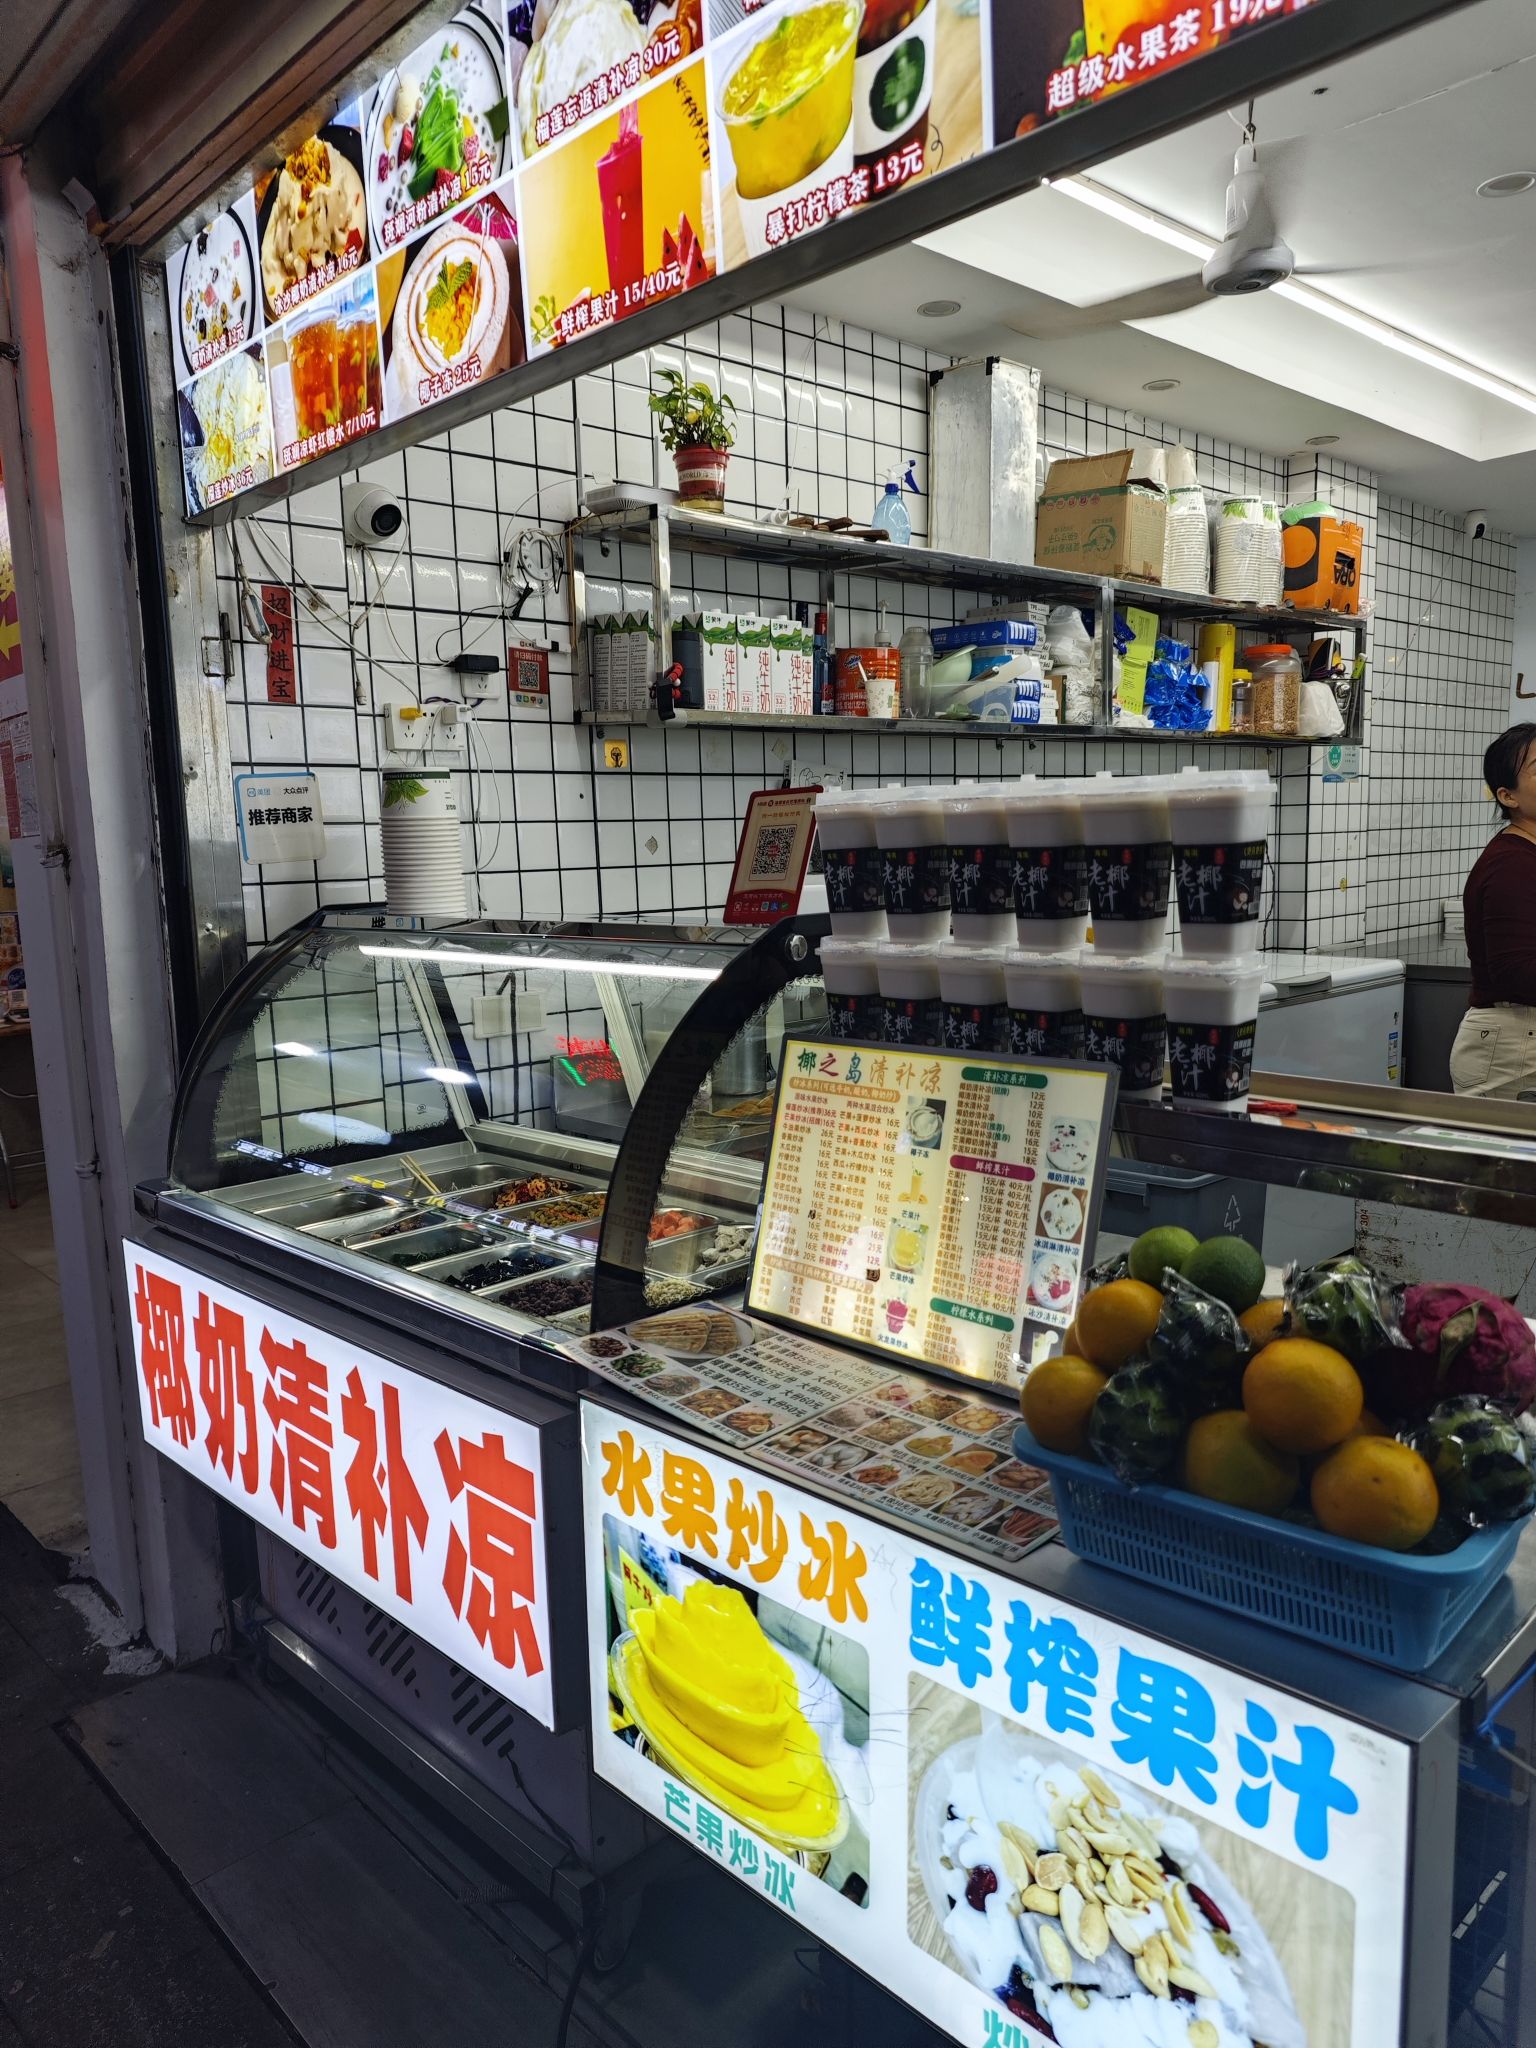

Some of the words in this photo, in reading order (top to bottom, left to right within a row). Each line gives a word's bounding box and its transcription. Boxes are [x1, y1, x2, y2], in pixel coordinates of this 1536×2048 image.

[1048, 8, 1202, 110] 超级水果茶
[536, 53, 641, 146] 榴莲忘返清补凉
[643, 29, 681, 73] 30元
[464, 154, 491, 191] 15元
[765, 163, 870, 244] 暴打柠檬茶
[874, 143, 924, 193] 13元
[274, 260, 336, 317] 冰沙椰奶清补凉
[337, 245, 358, 274] 16元
[559, 292, 620, 339] 鲜榨果汁
[624, 262, 683, 307] 15/40元
[418, 369, 454, 404] 椰子冻
[455, 355, 482, 389] 25元
[346, 412, 376, 436] 7/10元
[207, 477, 236, 504] 榴莲炒冰
[267, 593, 292, 698] 招财进宝
[725, 648, 736, 711] 纯牛奶
[759, 651, 770, 712] 纯牛奶
[791, 654, 802, 714] 纯牛奶
[283, 787, 308, 795] 大众点评
[248, 807, 313, 826] 推荐商家
[794, 1046, 944, 1094] 椰之岛清补凉
[983, 1071, 1027, 1085] 清补凉系列
[794, 1092, 828, 1104] 原味水果炒冰
[959, 1082, 1010, 1096] 椰奶清补凉(招牌)
[1030, 1091, 1046, 1101] 12元
[846, 1100, 895, 1114] 两种水果混合炒冰
[956, 1100, 989, 1112] 糖水清补凉
[1028, 1109, 1043, 1119] 10元
[1029, 1100, 1044, 1110] 12元
[840, 1110, 881, 1124] 芒果+菠萝炒冰
[886, 1117, 900, 1128] 16元
[954, 1117, 1005, 1133] 冰沙清补凉(推荐)
[1025, 1127, 1041, 1138] 16元
[1026, 1118, 1042, 1128] 16元
[780, 1133, 804, 1143] 香蕉炒冰
[838, 1122, 880, 1136] 芒果+西瓜炒冰
[884, 1129, 898, 1140] 16元
[953, 1126, 1010, 1143] 冰淇淋清补凉(推荐)
[1024, 1137, 1039, 1147] 16元
[779, 1142, 802, 1153] 木瓜炒冰
[836, 1134, 878, 1149] 芒果+香蕉炒冰
[882, 1142, 897, 1153] 16元
[910, 1148, 929, 1158] 椰子冻
[951, 1135, 998, 1150] 芒果椰奶清补凉
[1022, 1146, 1038, 1156] 15元
[778, 1151, 801, 1163] 柠檬炒冰
[834, 1146, 876, 1161] 芒果+木瓜炒冰
[880, 1155, 895, 1166] 16元
[1021, 1155, 1037, 1165] 18元
[776, 1161, 799, 1173] 西瓜炒冰
[833, 1158, 874, 1174] 西瓜+柠檬炒冰
[947, 1170, 966, 1181] 芒果汁
[975, 1160, 1010, 1175] 鲜榨果汁
[877, 1179, 891, 1190] 16元
[946, 1179, 965, 1190] 西瓜汁
[1046, 1171, 1086, 1187] 椰奶清补凉
[829, 1182, 864, 1197] 芒果+哈密瓜
[875, 1192, 889, 1203] 16元
[945, 1188, 964, 1199] 木瓜汁
[873, 1204, 888, 1216] 16元
[901, 1209, 920, 1221] 芒果汁
[871, 1217, 886, 1228] 16元
[870, 1230, 884, 1241] 16元
[1033, 1237, 1080, 1257] 冰淇淋清补凉
[866, 1255, 880, 1267] 12元
[889, 1271, 914, 1285] 芒果炒冰
[790, 1285, 803, 1296] 木瓜
[950, 1304, 994, 1326] 柠檬水系列
[1027, 1306, 1067, 1325] 冰沙清补凉
[927, 1311, 947, 1324] 柠檬水
[1001, 1332, 1012, 1343] 7元
[877, 1333, 908, 1350] 火龙果炒冰
[996, 1340, 1011, 1352] 10元
[993, 1359, 1008, 1371] 10元
[994, 1350, 1010, 1362] 10元
[811, 1374, 859, 1395] 大份50元
[992, 1369, 1007, 1381] 10元
[778, 1388, 826, 1410] 大份60元
[795, 1381, 843, 1402] 大份50元
[760, 1395, 810, 1418] 大份50元
[135, 1264, 544, 1677] 椰奶清补凉
[600, 1430, 869, 1623] 水果炒冰
[909, 1557, 1359, 1861] 鲜榨果汁
[664, 1781, 797, 1913] 芒果炒冰
